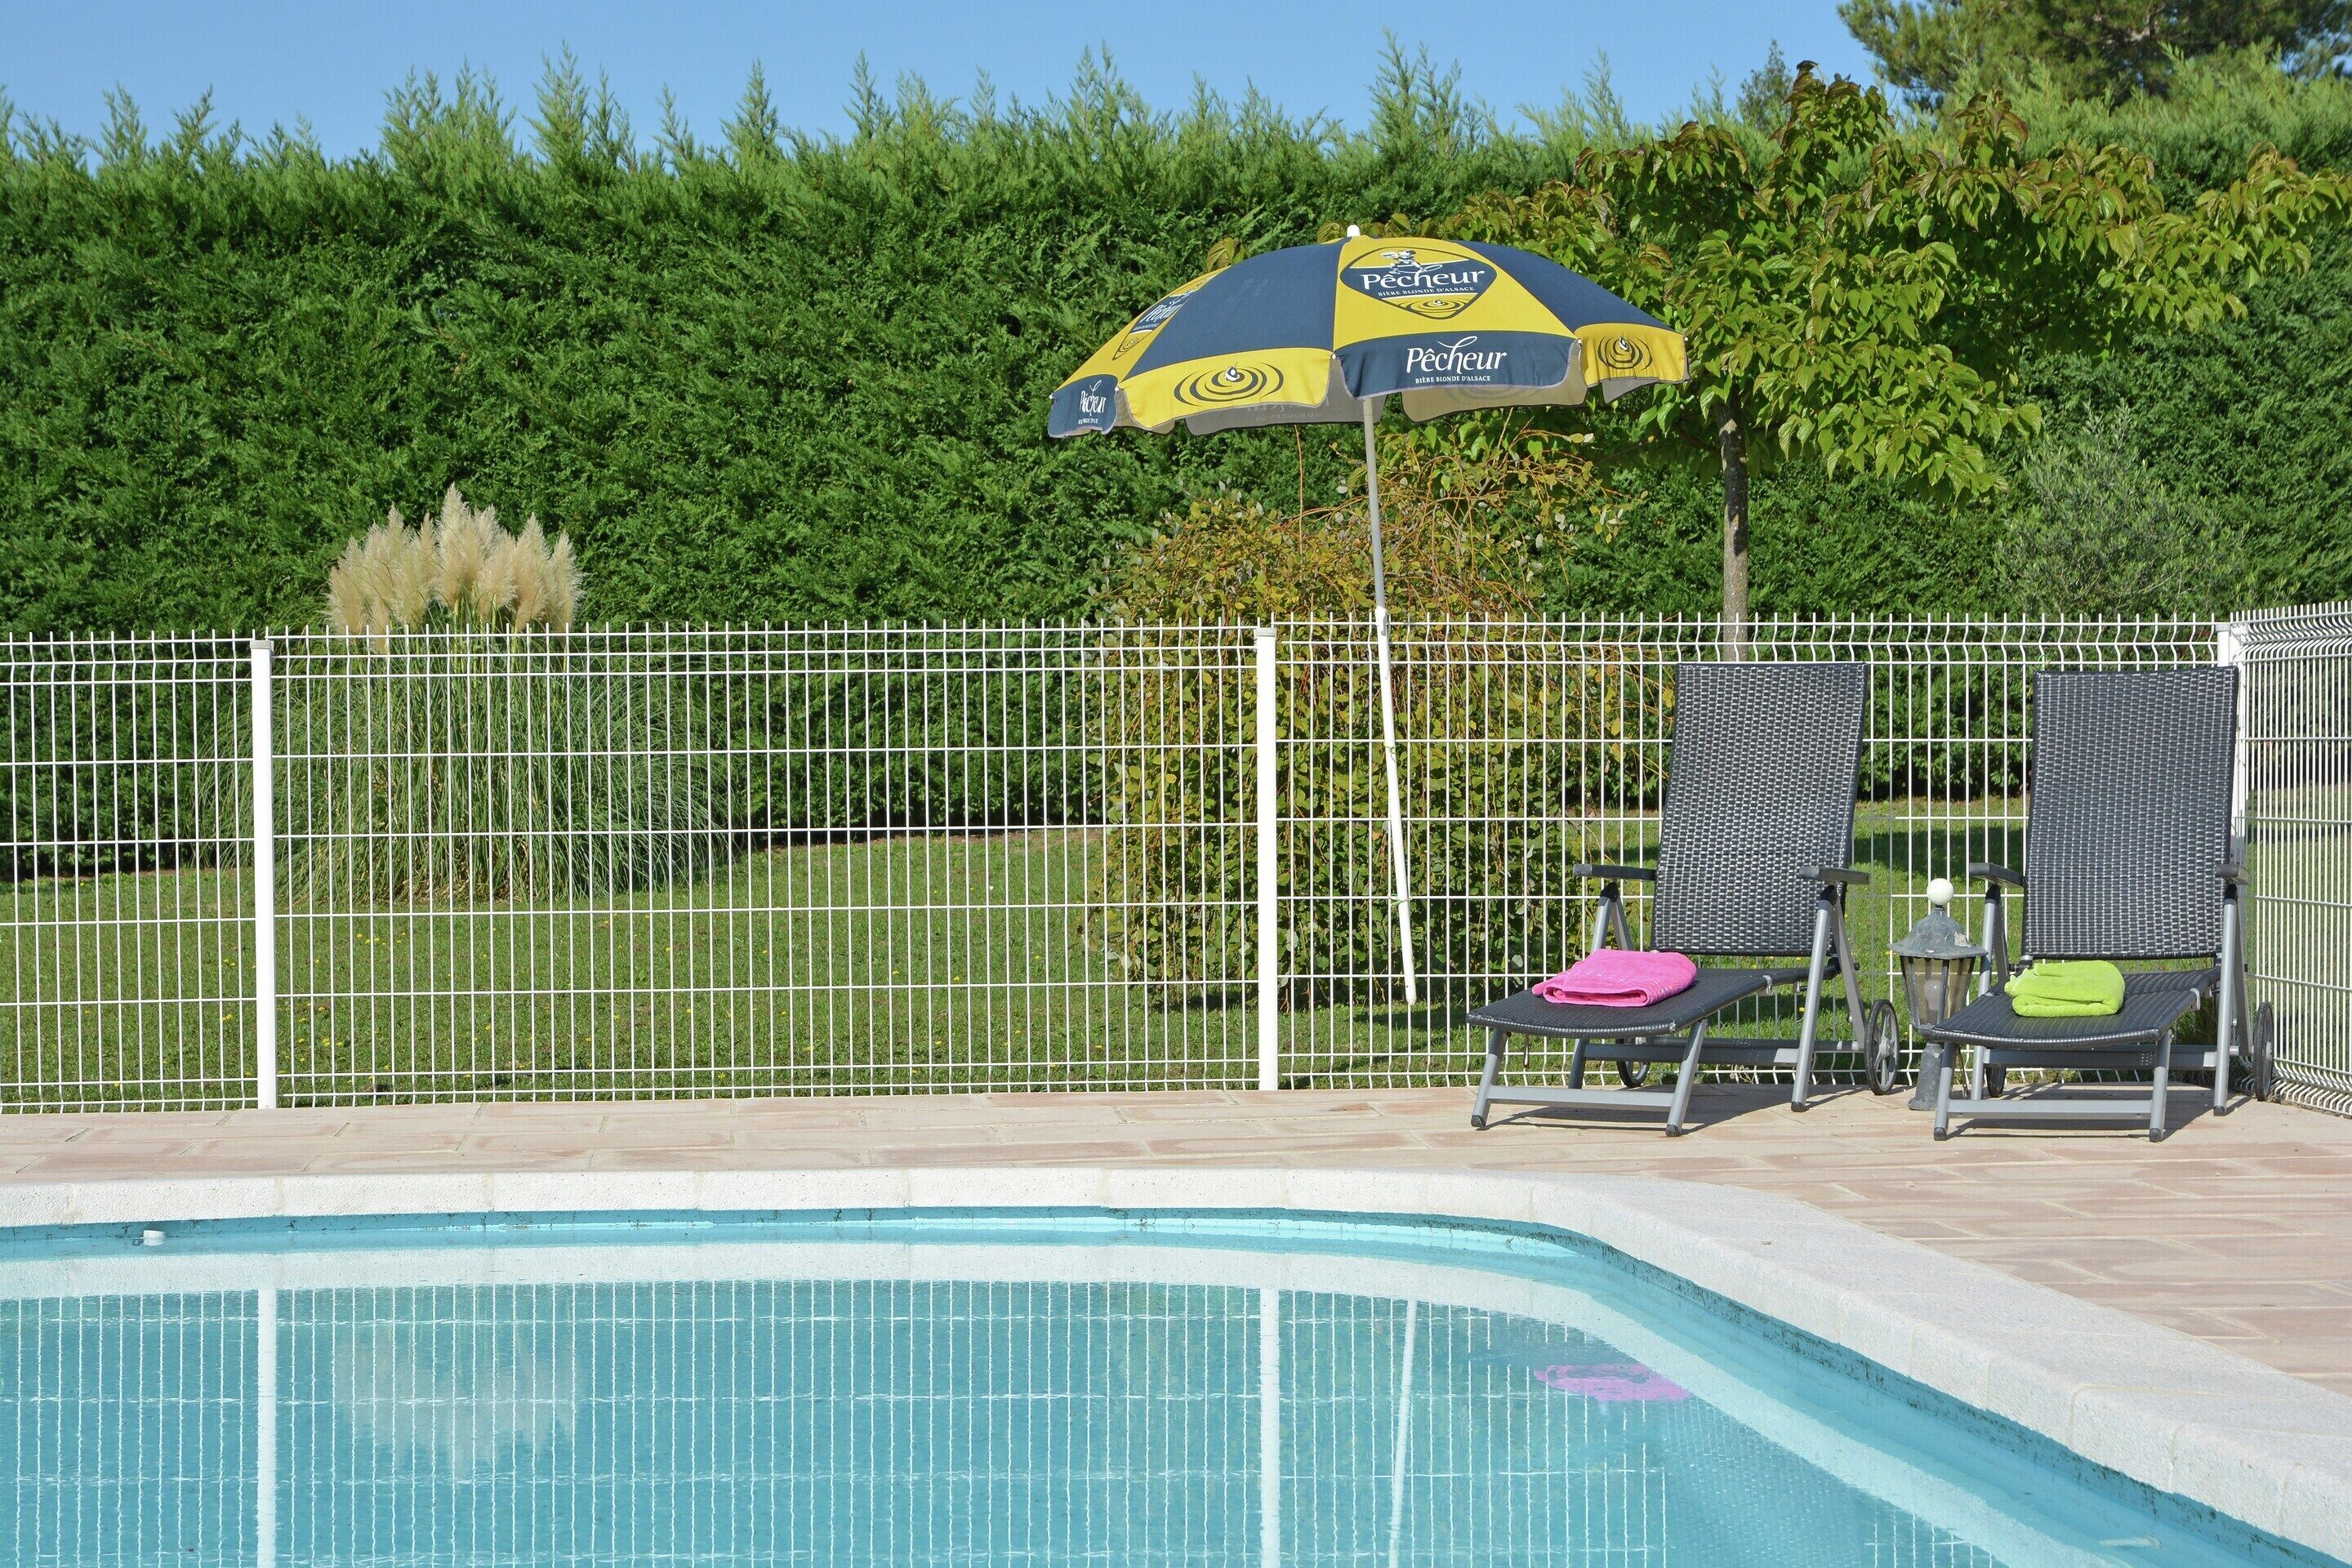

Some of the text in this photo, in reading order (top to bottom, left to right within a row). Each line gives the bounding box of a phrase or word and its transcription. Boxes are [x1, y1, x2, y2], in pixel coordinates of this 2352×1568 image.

[1360, 270, 1486, 290] Pêcheur
[1406, 336, 1508, 375] Pêcheur
[1415, 376, 1435, 384] BIÈRE
